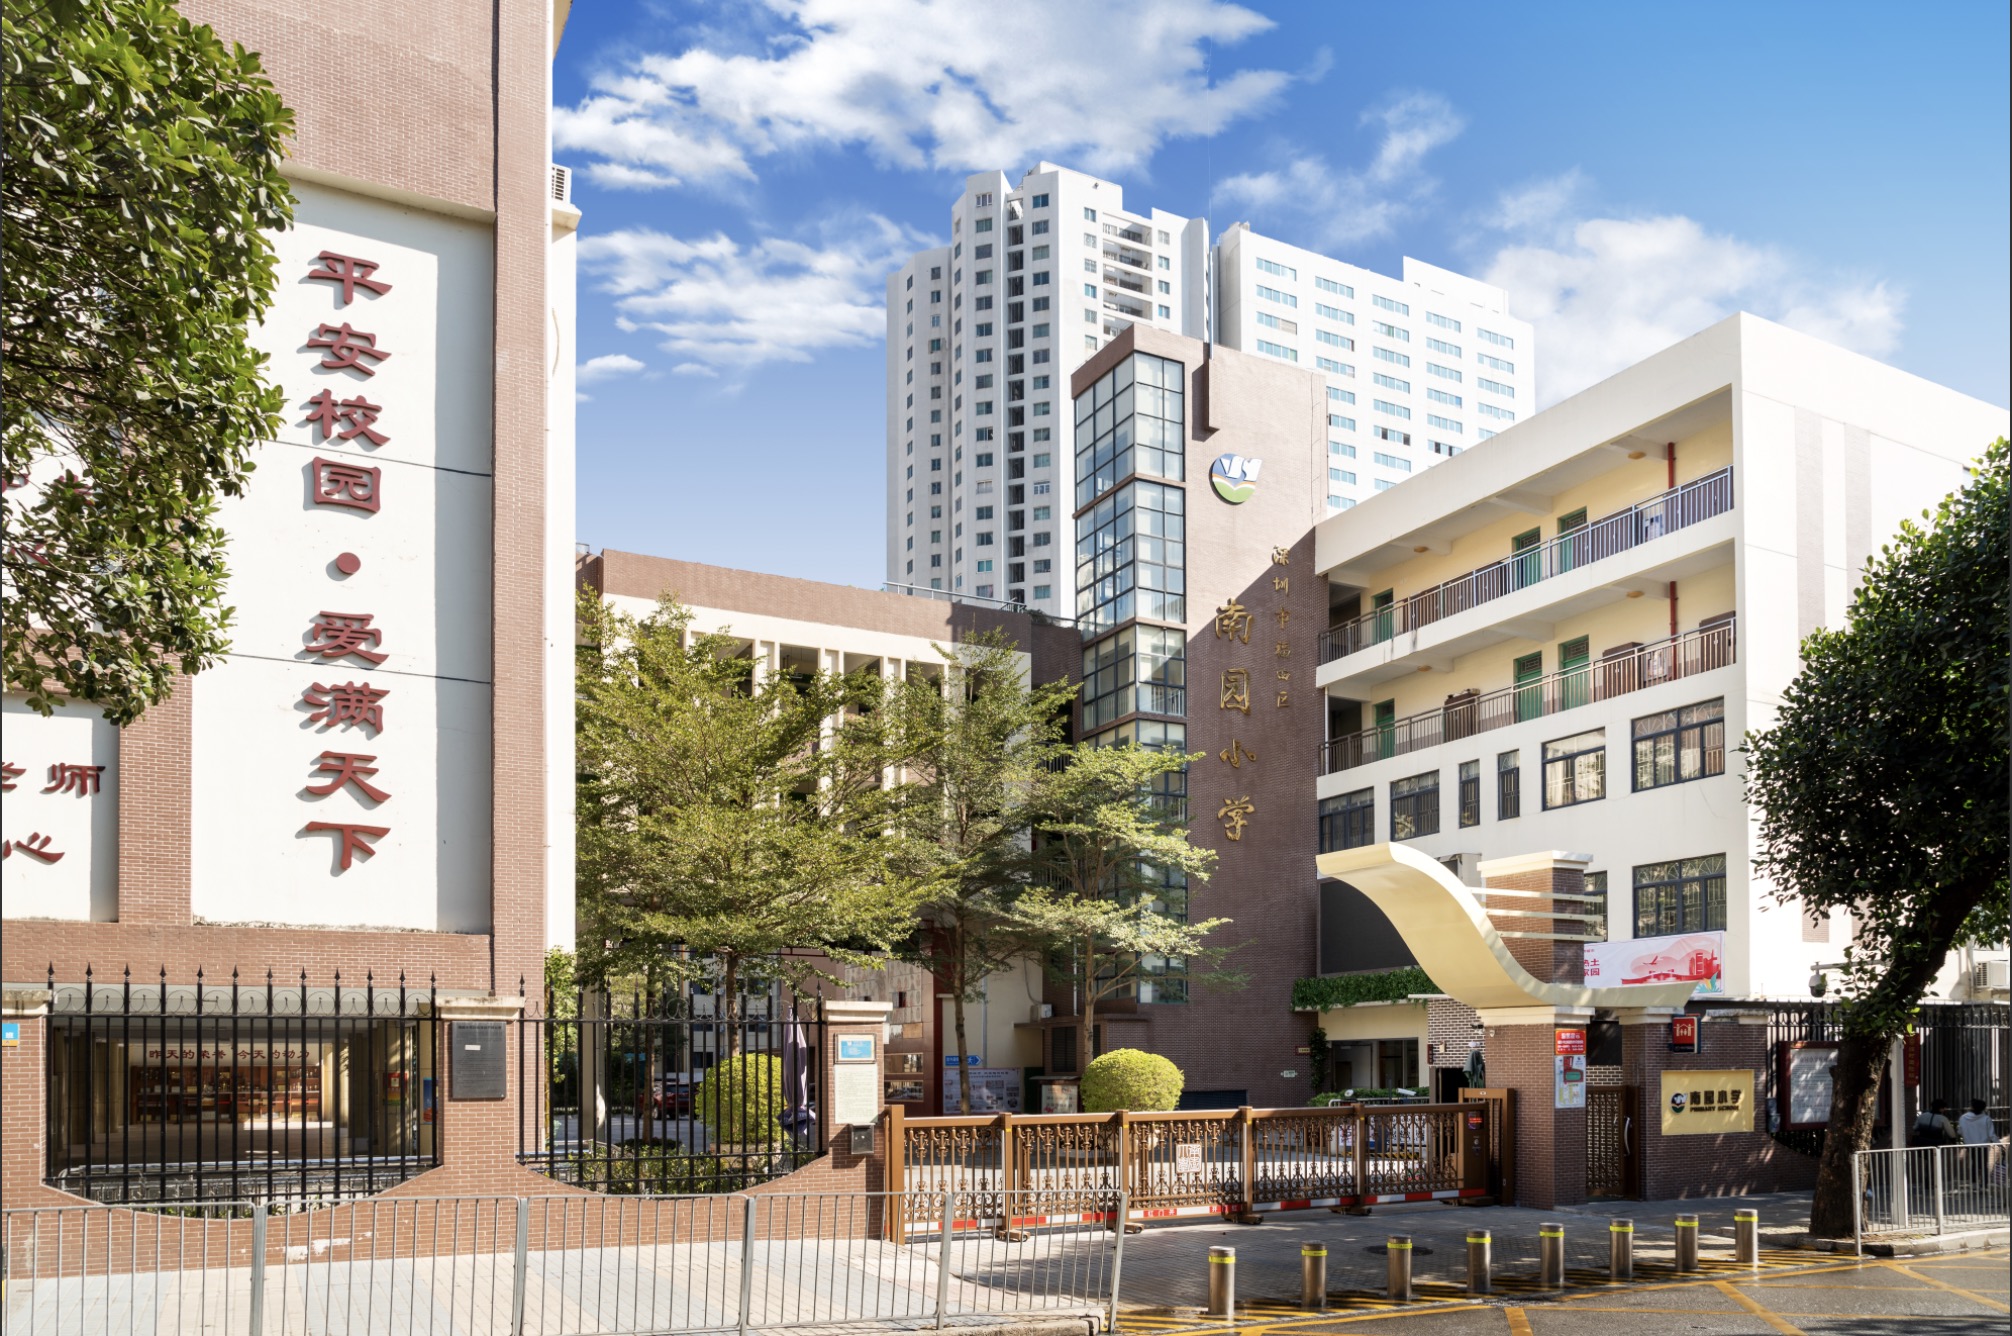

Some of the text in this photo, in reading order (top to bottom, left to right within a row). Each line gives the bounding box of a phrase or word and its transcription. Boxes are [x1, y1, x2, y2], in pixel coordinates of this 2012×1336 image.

[1215, 597, 1256, 841] 南园小学
[1273, 545, 1291, 708] 深圳市福田区
